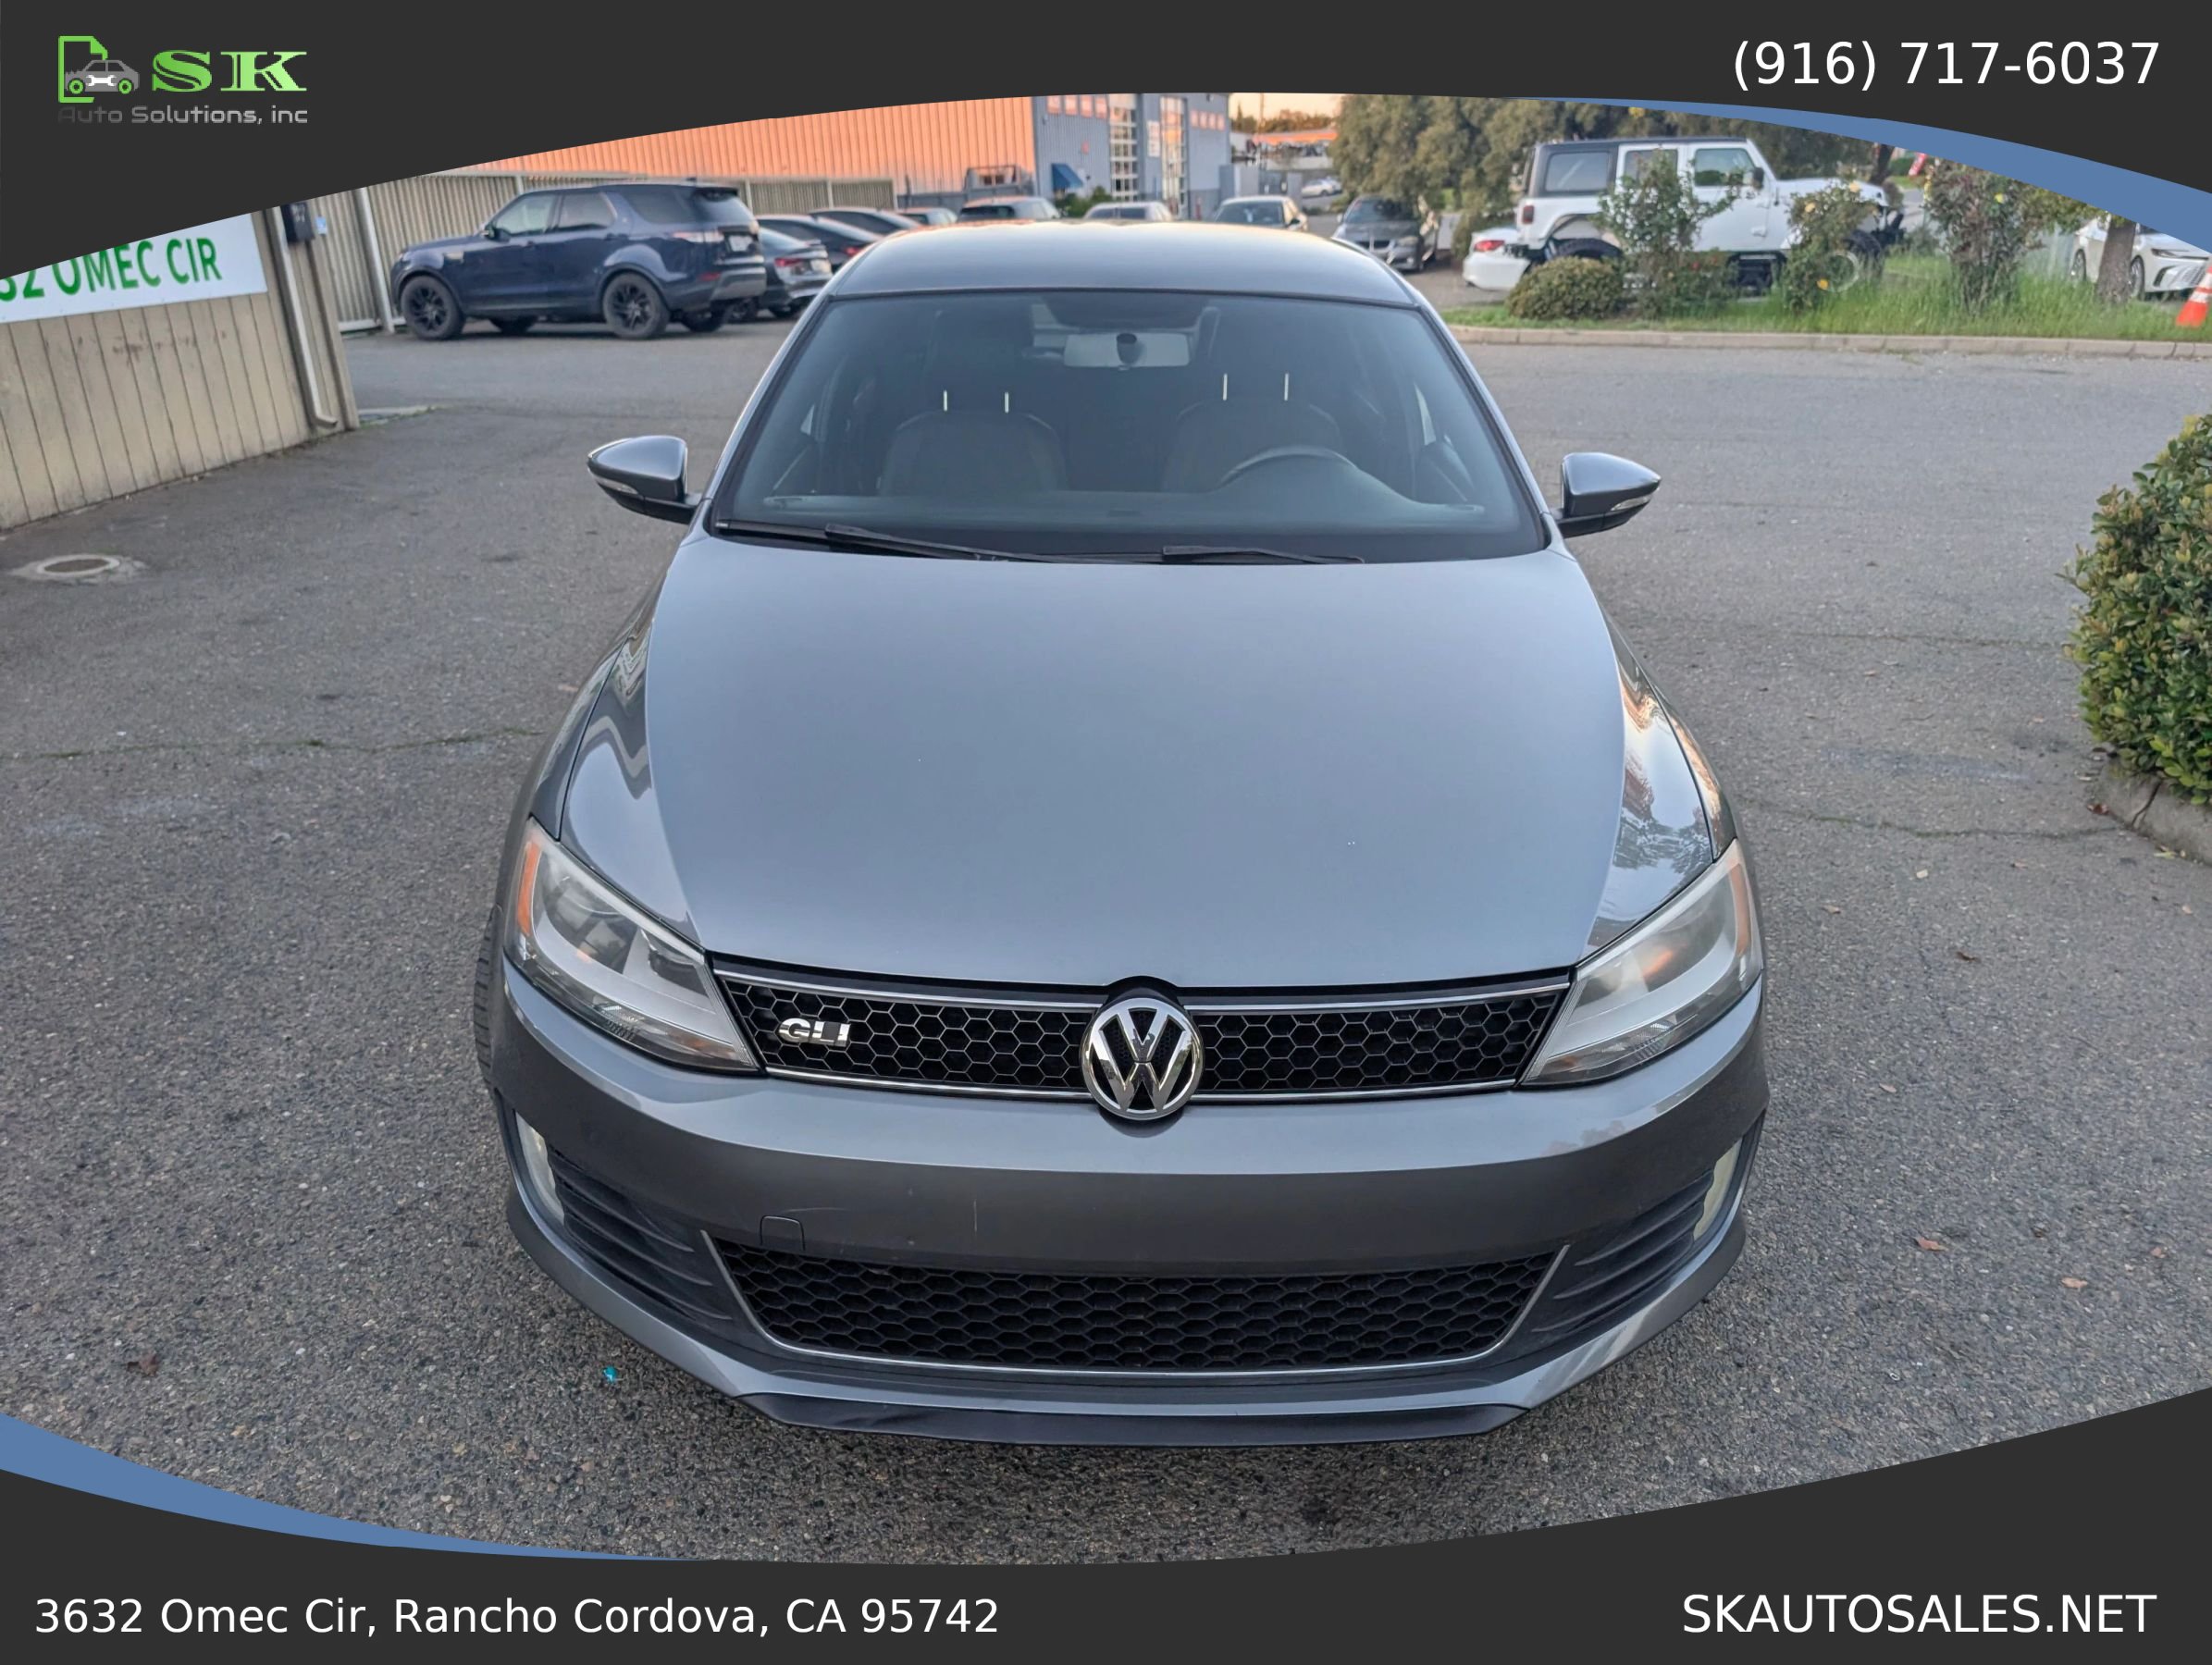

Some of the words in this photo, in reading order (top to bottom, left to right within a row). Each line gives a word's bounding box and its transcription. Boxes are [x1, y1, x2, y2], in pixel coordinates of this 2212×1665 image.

[52, 240, 161, 295] OMEC
[167, 238, 222, 284] CIR
[779, 1018, 850, 1047] GLI
